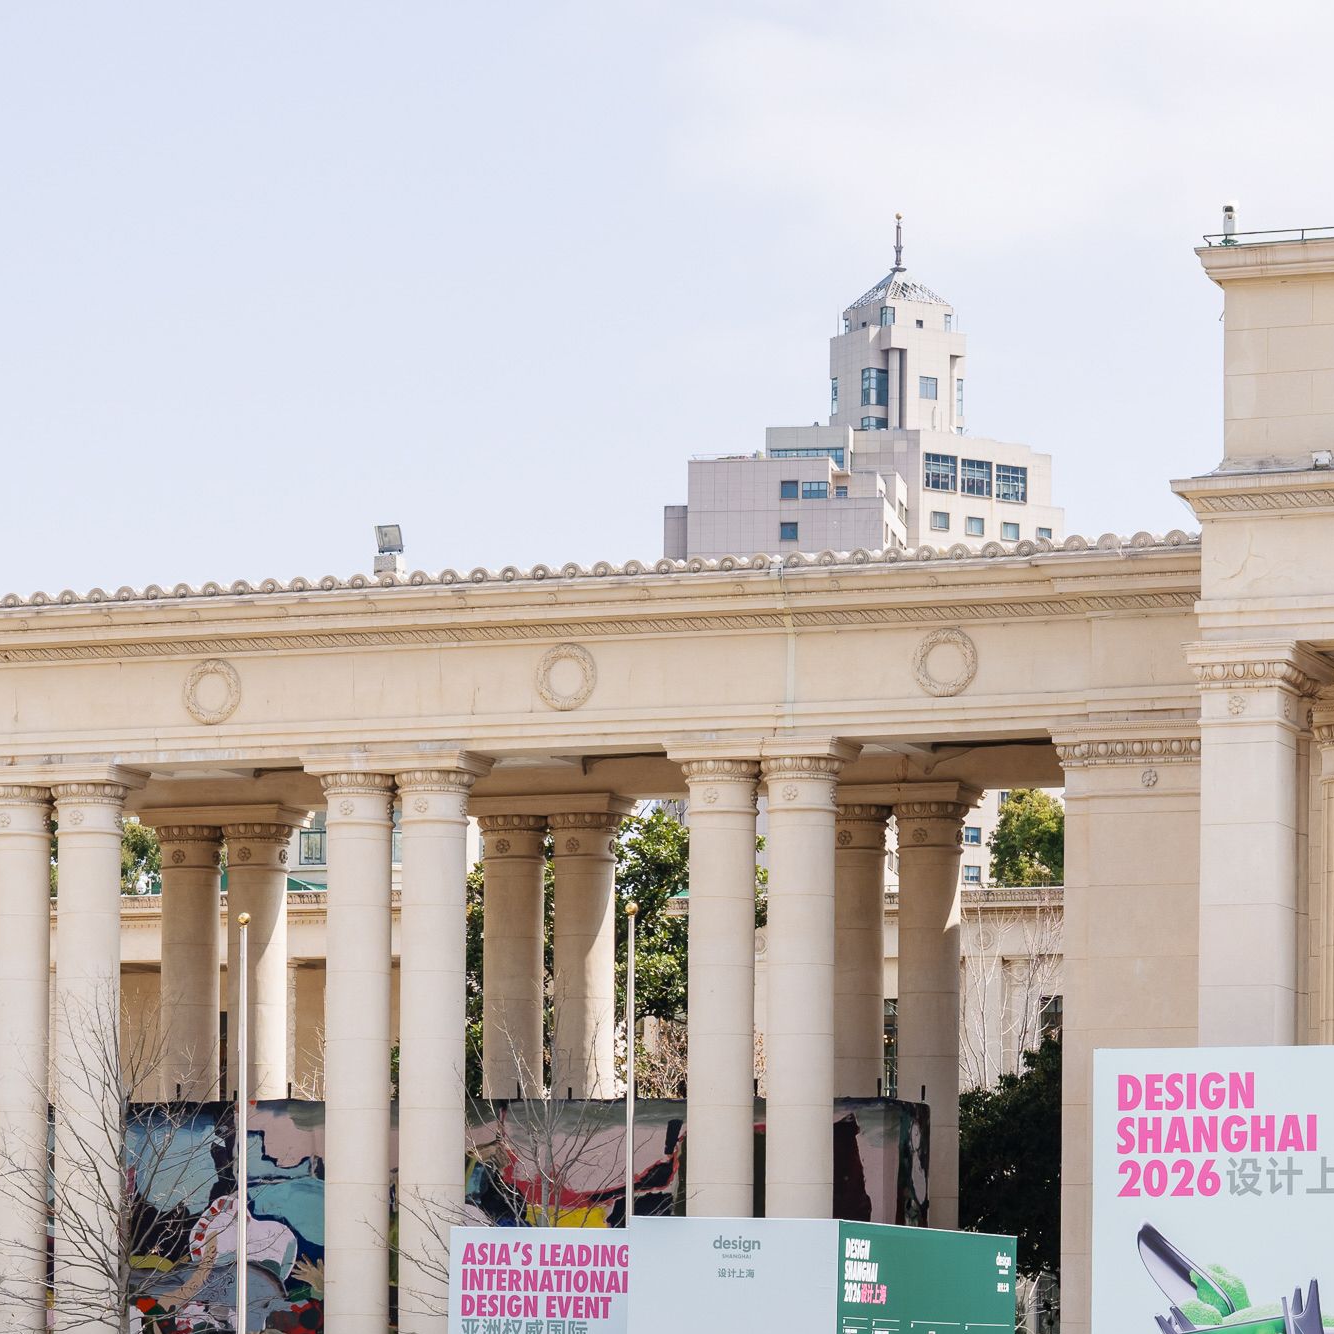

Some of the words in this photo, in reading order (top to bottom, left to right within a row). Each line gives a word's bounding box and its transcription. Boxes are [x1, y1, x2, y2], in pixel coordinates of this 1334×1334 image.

[1117, 1071, 1255, 1111] DESIGN
[1116, 1114, 1317, 1154] SHANGHAI
[1117, 1158, 1221, 1198] 2026
[462, 1242, 533, 1266] ASIA'S
[539, 1243, 629, 1268] LEADING
[713, 1234, 761, 1253] design
[845, 1238, 871, 1260] DESIGN
[717, 1268, 755, 1278] 设计上海
[844, 1260, 879, 1283] SHANGHAI
[843, 1284, 861, 1303] 2026
[461, 1294, 538, 1318] DESIGN
[545, 1296, 612, 1319] EVENT
